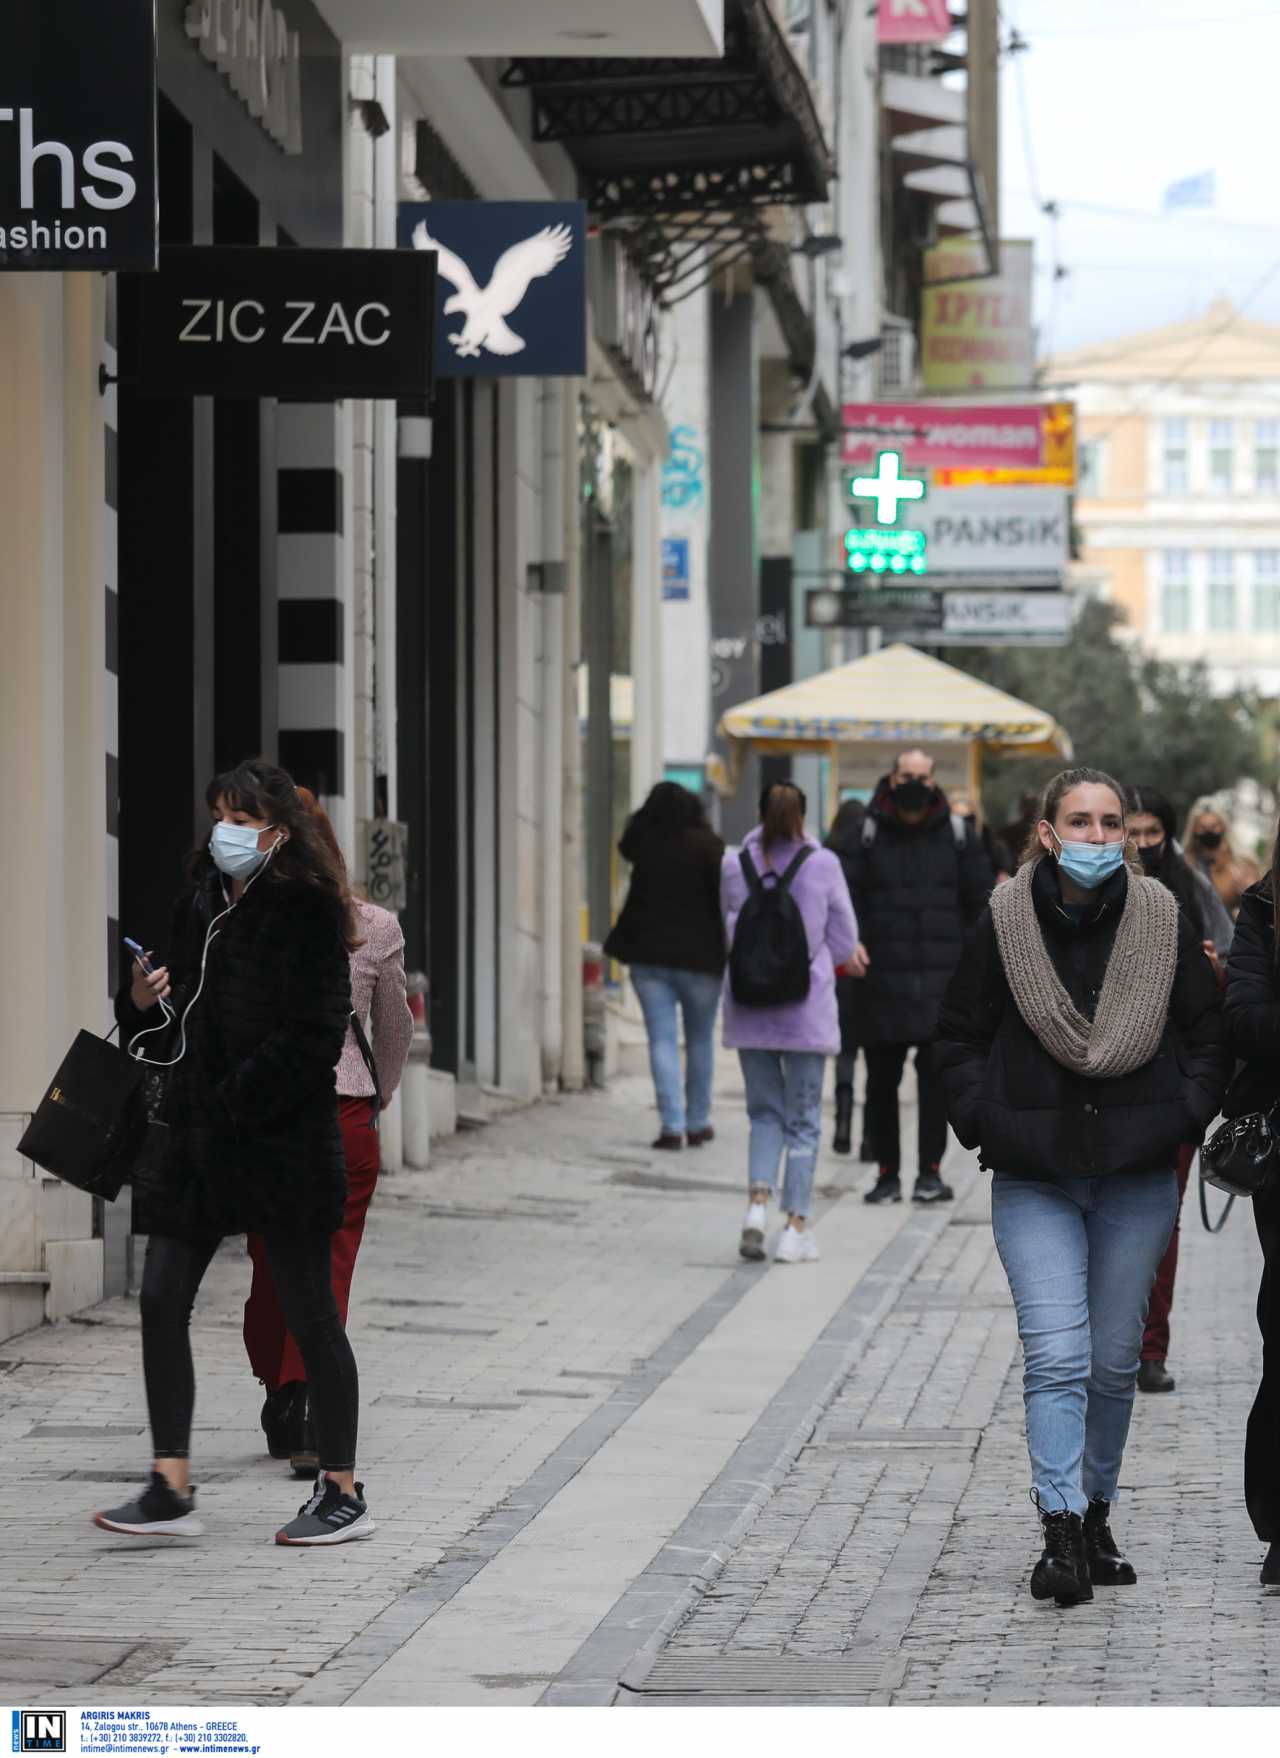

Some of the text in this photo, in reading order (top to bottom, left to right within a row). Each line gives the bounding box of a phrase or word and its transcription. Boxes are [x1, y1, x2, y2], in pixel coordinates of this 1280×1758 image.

[179, 299, 391, 346] ZIC ZAC
[924, 423, 1038, 449] woman
